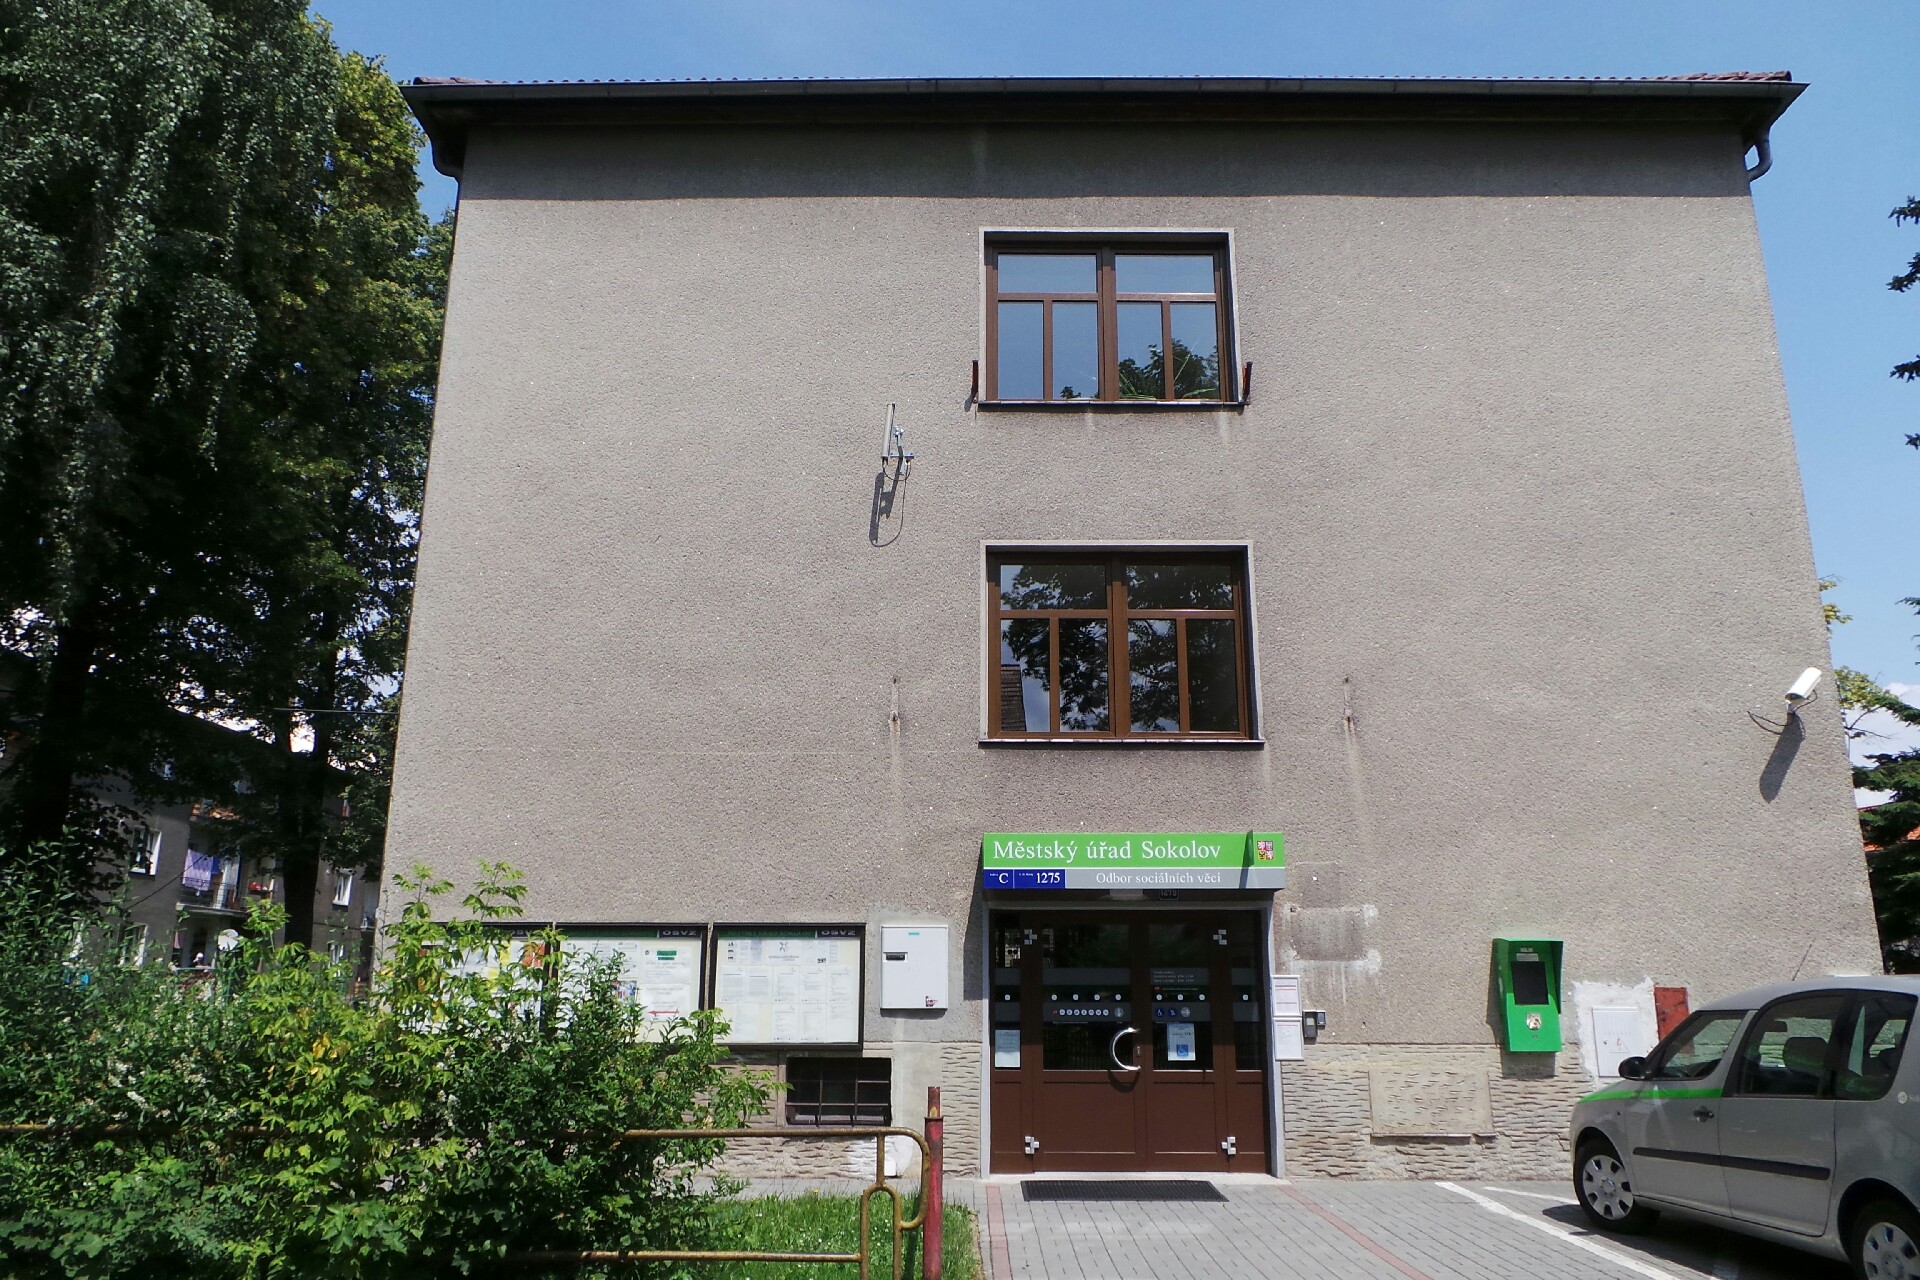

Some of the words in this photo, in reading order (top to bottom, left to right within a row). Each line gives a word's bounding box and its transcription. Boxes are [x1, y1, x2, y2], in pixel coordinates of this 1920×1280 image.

[993, 840, 1077, 863] Městský
[1086, 840, 1132, 859] úřad
[1141, 839, 1221, 859] Sokolov
[998, 872, 1009, 884] C
[1036, 872, 1061, 884] 1275
[1096, 872, 1132, 884] Odbor
[1135, 872, 1194, 884] sociálních
[1197, 872, 1221, 884] věcí
